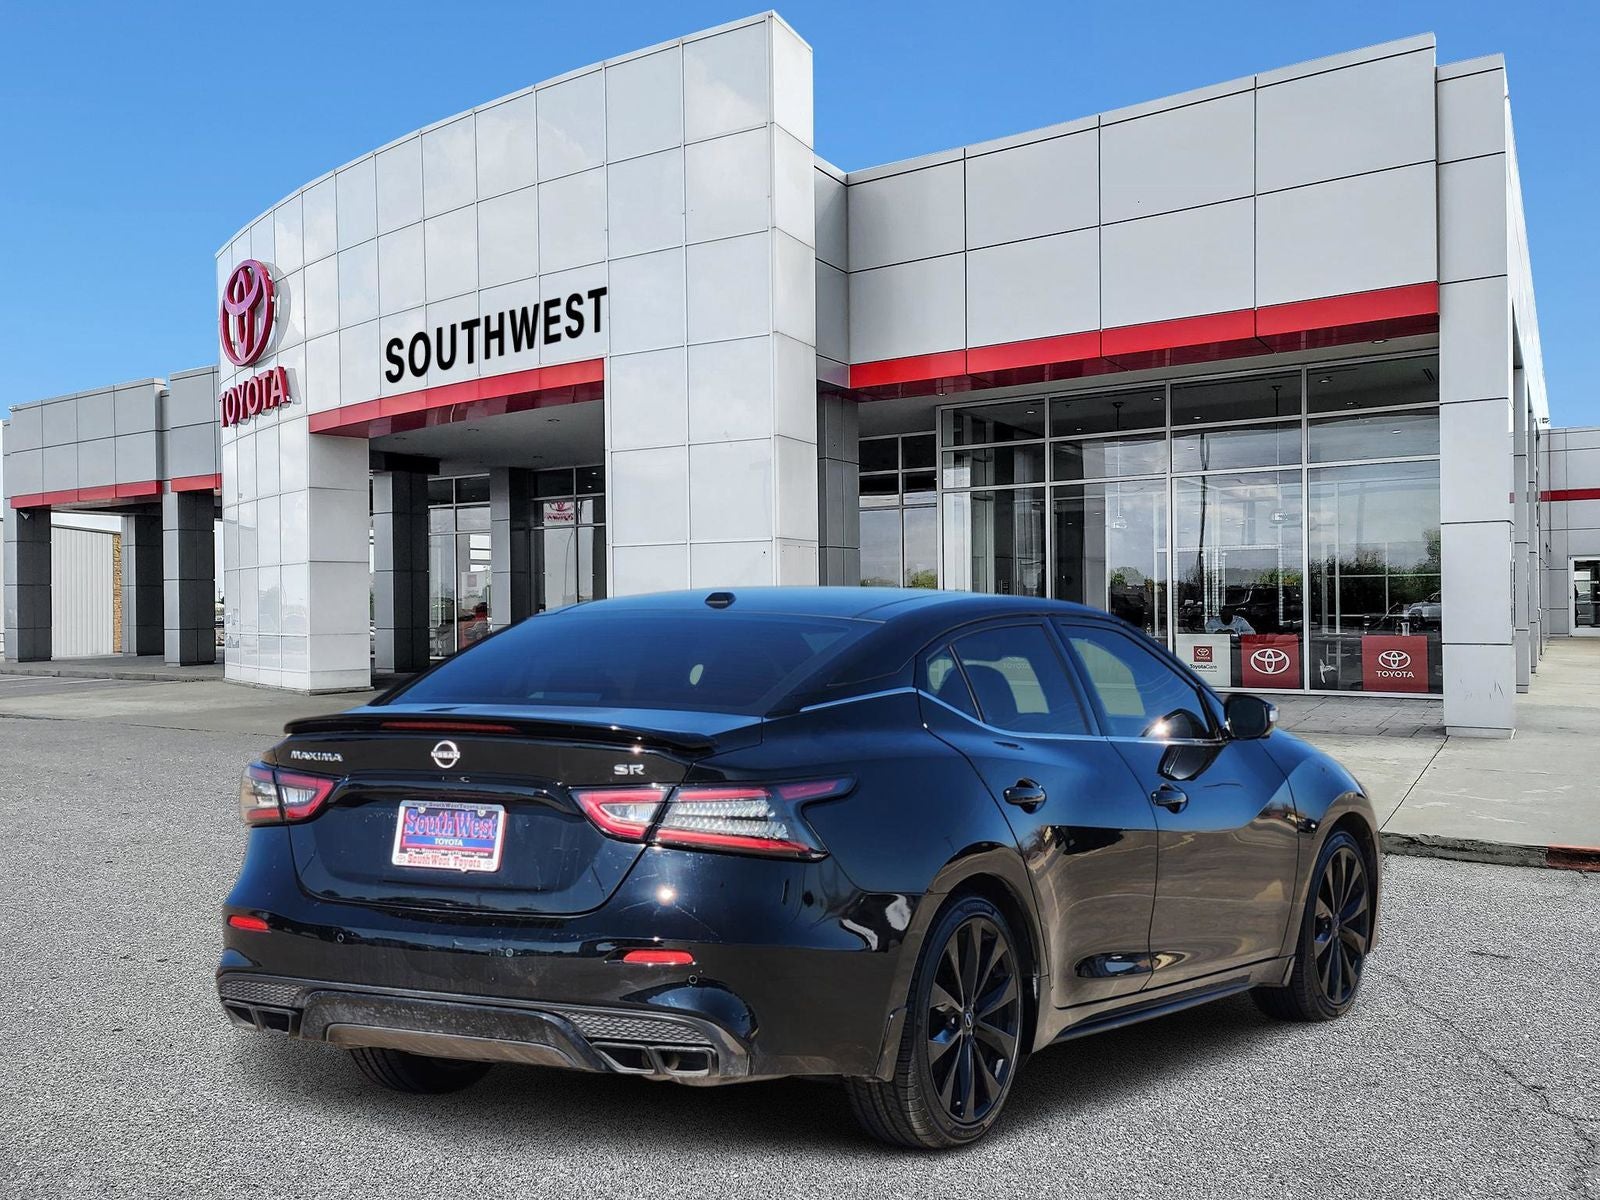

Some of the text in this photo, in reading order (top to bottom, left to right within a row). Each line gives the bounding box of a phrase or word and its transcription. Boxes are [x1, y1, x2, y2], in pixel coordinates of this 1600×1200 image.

[385, 287, 608, 383] SOUTHWEST
[218, 366, 291, 428] TOYOTA
[1376, 670, 1414, 678] TOYOTA
[290, 750, 343, 762] MAXIMA
[431, 751, 460, 759] NISSAN
[614, 764, 645, 775] SR
[434, 838, 463, 847] TOYOTA
[453, 856, 481, 869] Toyota
